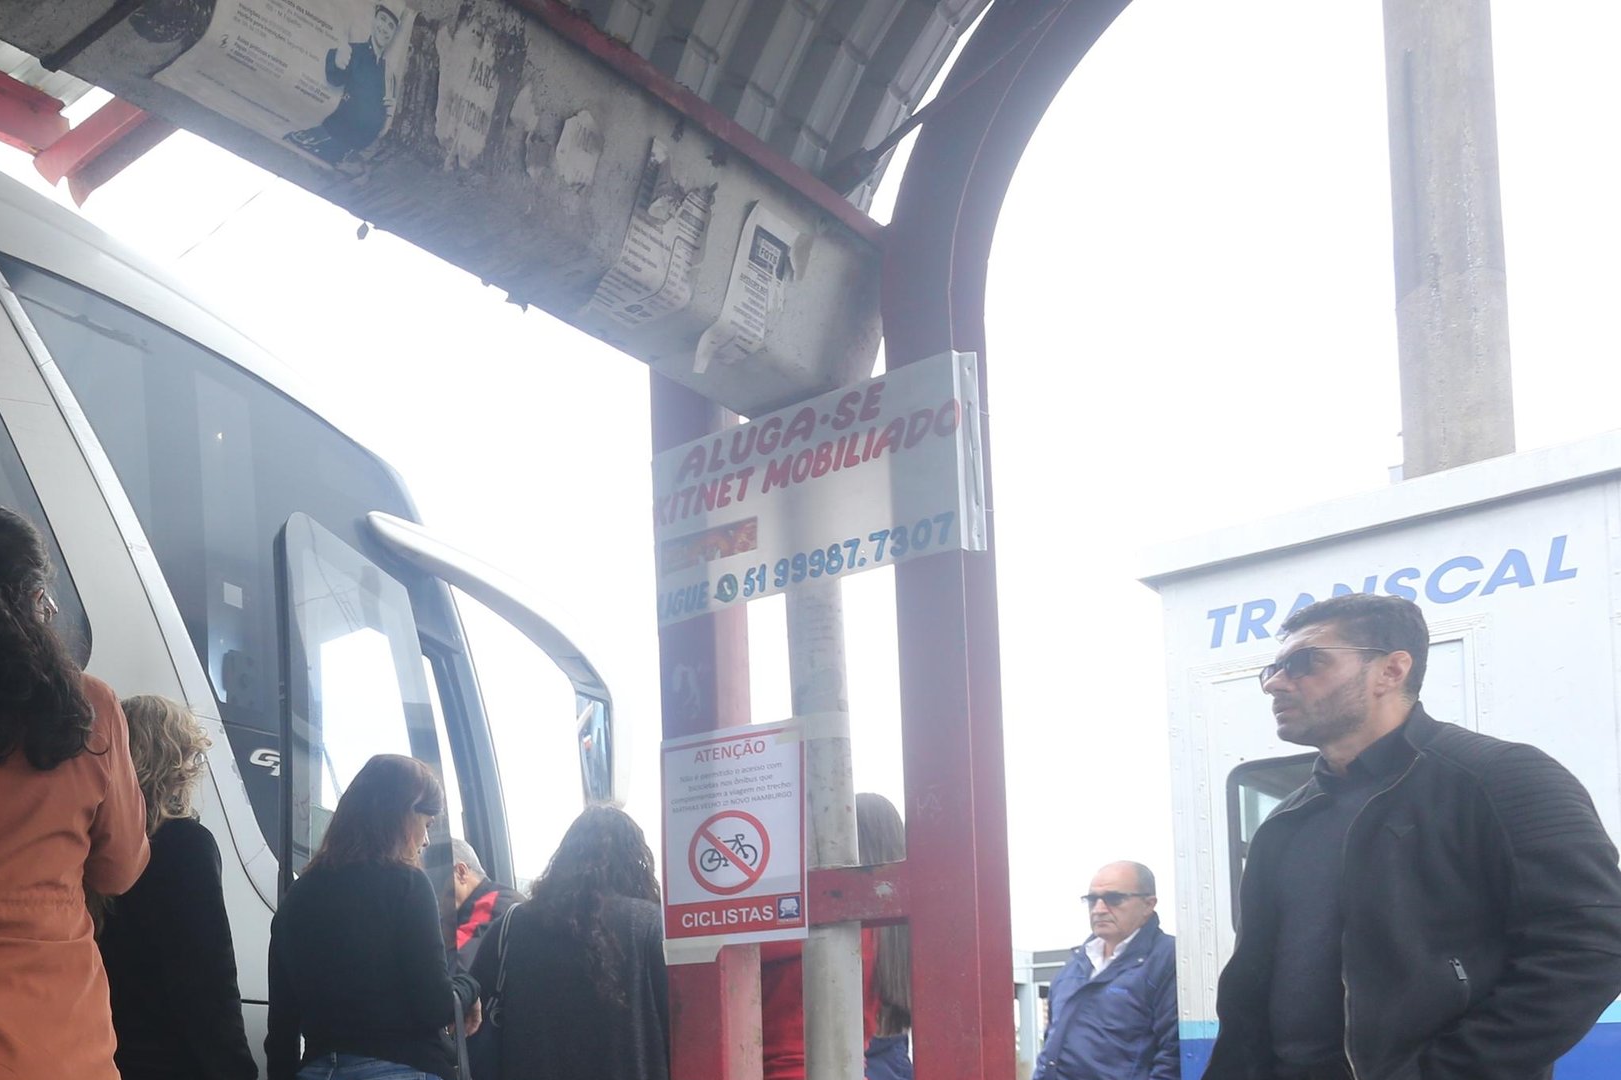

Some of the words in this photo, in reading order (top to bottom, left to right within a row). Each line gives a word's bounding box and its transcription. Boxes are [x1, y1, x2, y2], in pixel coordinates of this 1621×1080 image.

[761, 398, 961, 495] MOBILIADO
[655, 467, 755, 526] KITNET
[743, 563, 767, 598] 51
[694, 739, 766, 764] ATENÇÃO
[700, 768, 734, 781] permitido
[741, 764, 765, 774] acesso
[766, 761, 783, 770] com
[720, 779, 732, 787] nos
[734, 776, 758, 786] ônibus
[759, 774, 773, 783] que
[730, 787, 754, 798] viagem
[756, 785, 765, 793] no
[730, 796, 750, 806] NOVO
[751, 791, 793, 803] HAMBURGO
[681, 904, 774, 928] CICLISTAS
